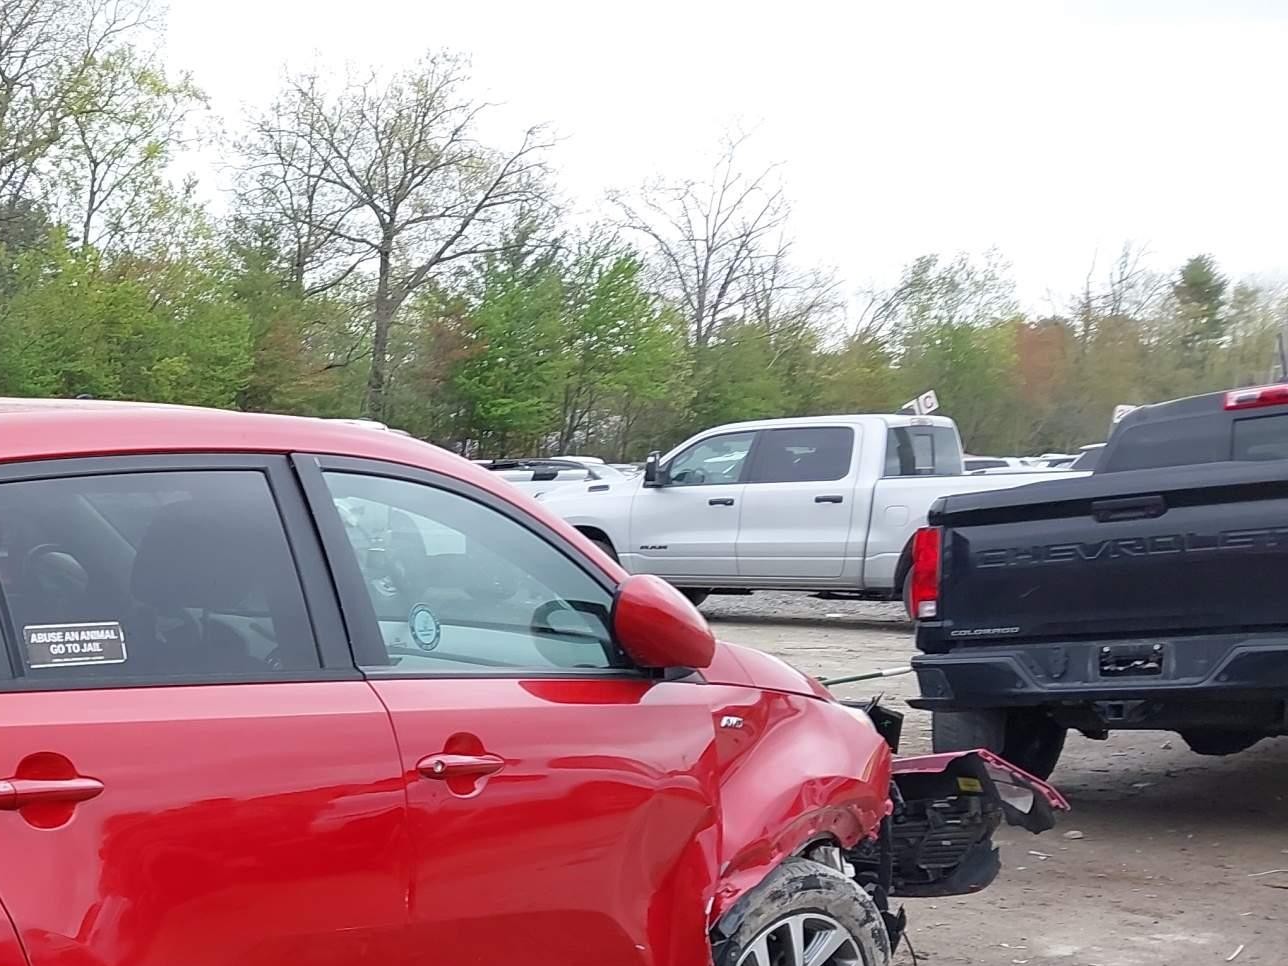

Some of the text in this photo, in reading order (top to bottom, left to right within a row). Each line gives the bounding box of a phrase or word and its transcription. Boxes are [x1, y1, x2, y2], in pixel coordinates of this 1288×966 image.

[30, 629, 119, 644] ABUSE AN ANIMAL
[950, 626, 1021, 637] COLORADO
[50, 642, 104, 655] GO TO JAIL
